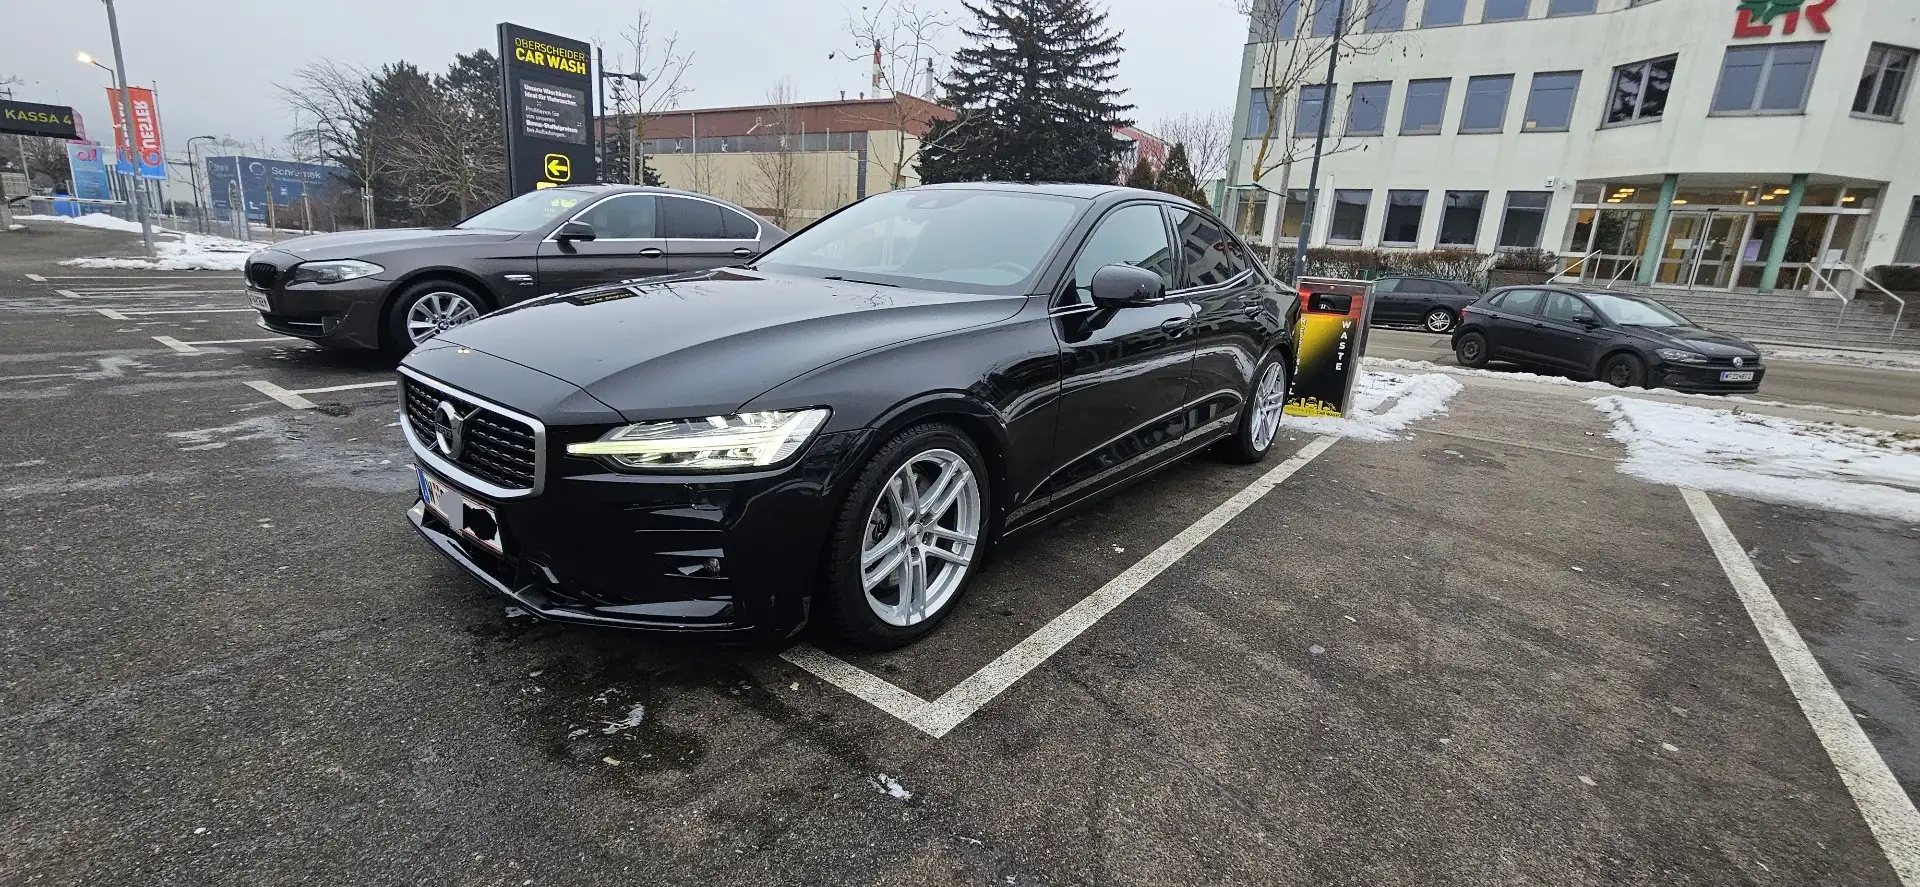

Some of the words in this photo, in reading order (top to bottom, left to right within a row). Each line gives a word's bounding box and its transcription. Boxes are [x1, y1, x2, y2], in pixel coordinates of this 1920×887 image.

[515, 38, 585, 62] OBERSCHEIDER
[515, 47, 545, 66] CAR
[546, 54, 586, 75] WASH
[523, 83, 543, 93] Unsere
[543, 88, 572, 99] Waschkarte
[524, 91, 538, 99] Ideal
[4, 108, 60, 124] KASSA
[63, 114, 72, 125] 4
[525, 105, 552, 116] Profitieren
[535, 115, 556, 123] unseren
[526, 126, 535, 134] bei
[1335, 320, 1352, 371] WASTE
